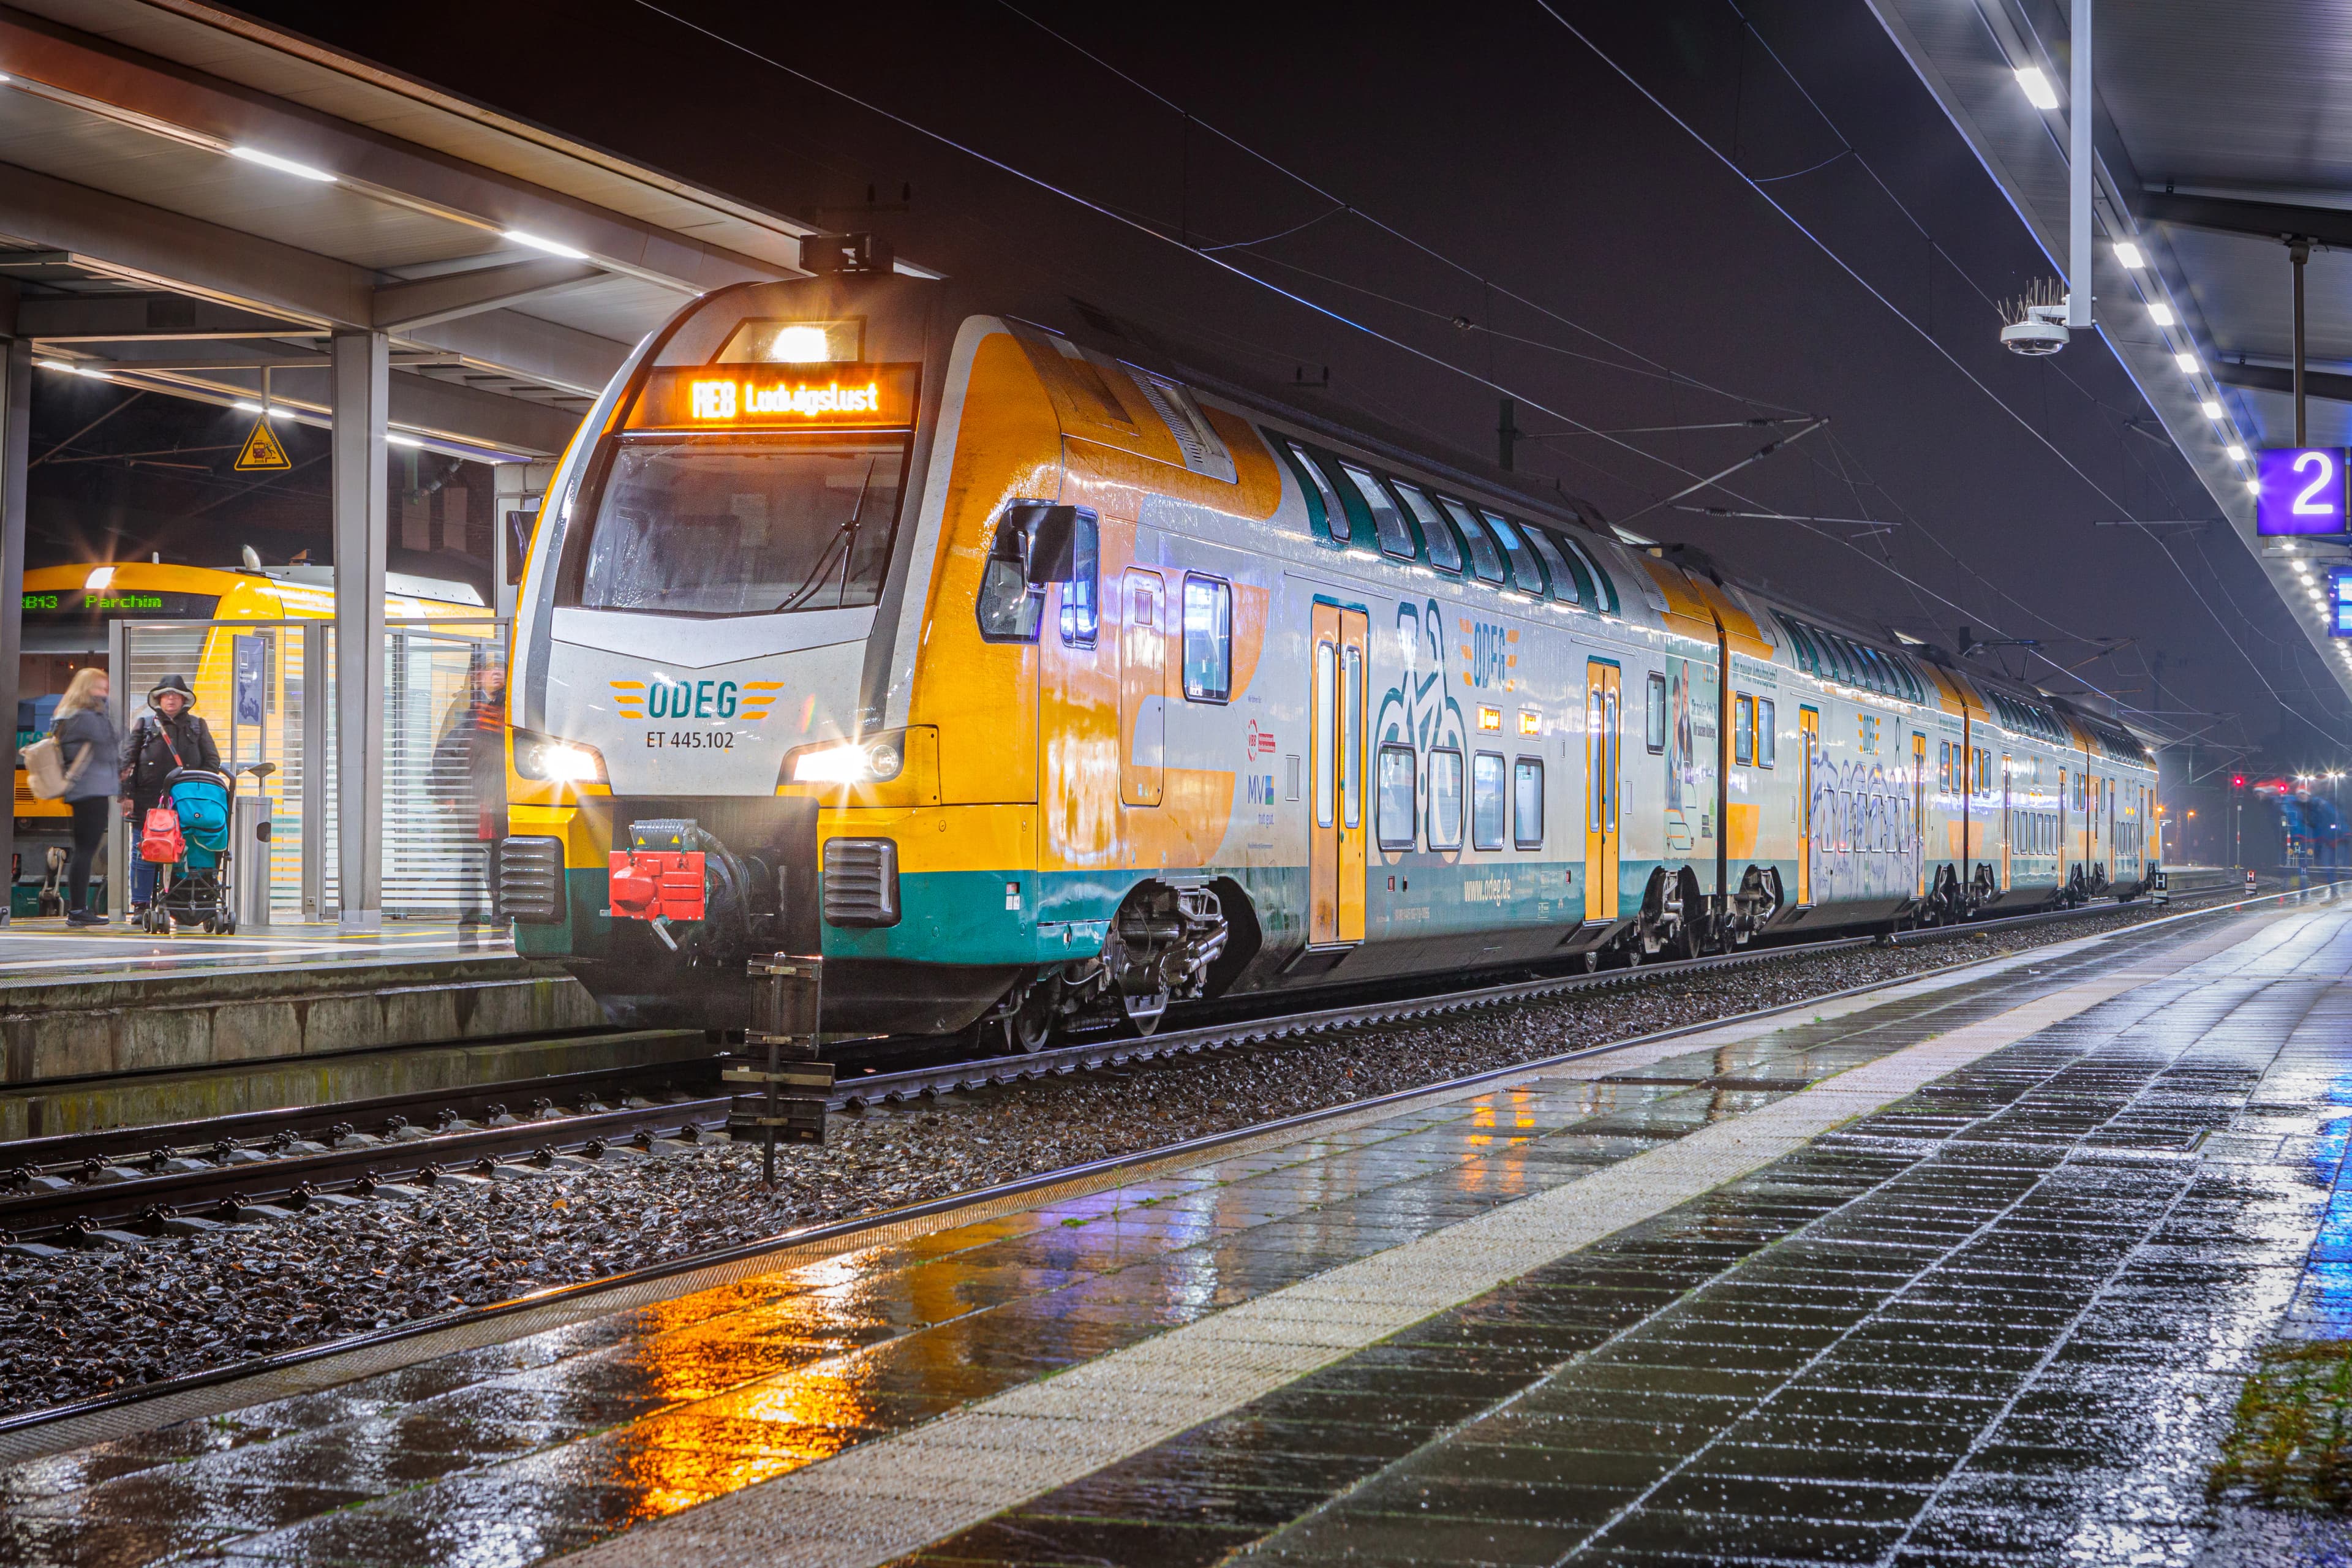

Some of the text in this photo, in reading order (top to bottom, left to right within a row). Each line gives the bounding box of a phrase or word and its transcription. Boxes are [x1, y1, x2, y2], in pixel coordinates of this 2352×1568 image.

[693, 382, 878, 418] RE8 Ludwigslust
[2293, 452, 2333, 514] 2
[21, 595, 162, 608] B13 Parchim
[649, 680, 737, 718] ODEG
[647, 732, 733, 748] ET 445.102
[1248, 775, 1265, 804] MV
[1464, 872, 1510, 906] www.odeg.de
[2156, 874, 2166, 888] H
[2247, 872, 2254, 881] H
